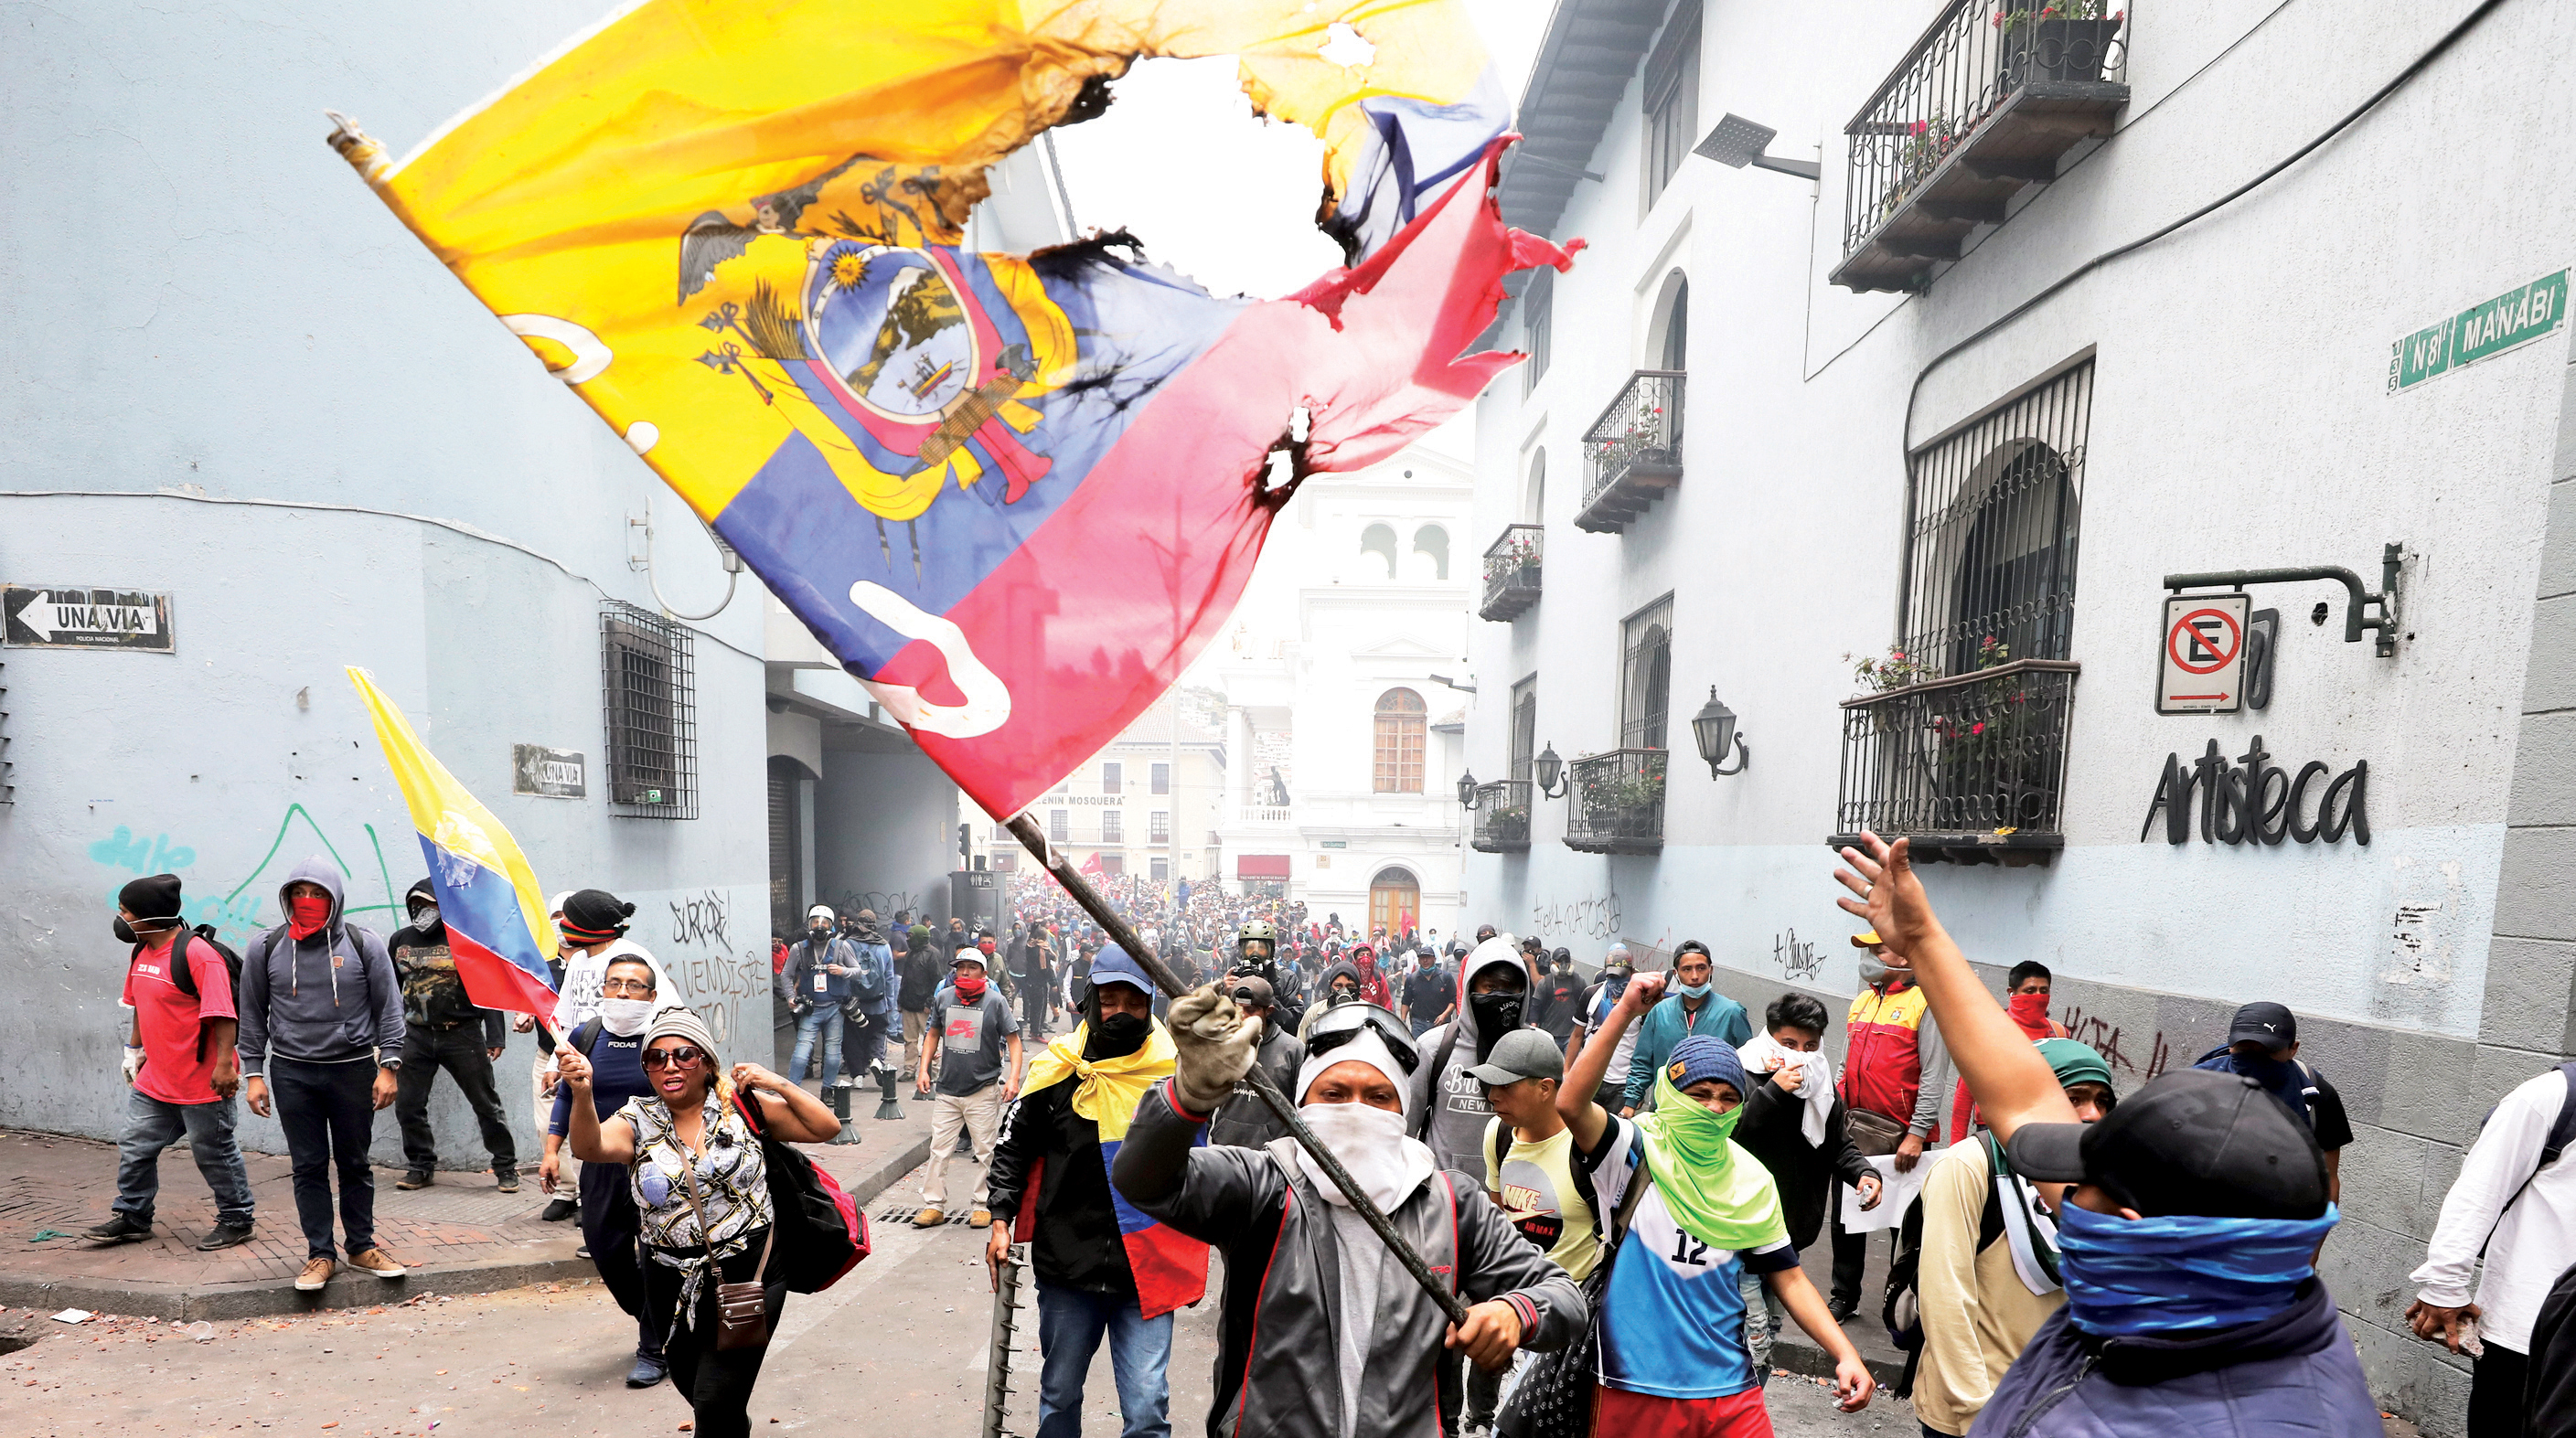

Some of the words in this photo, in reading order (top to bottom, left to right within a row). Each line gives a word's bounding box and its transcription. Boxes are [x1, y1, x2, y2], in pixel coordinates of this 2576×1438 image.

[2463, 284, 2555, 354] MANABI
[2389, 377, 2398, 391] 5
[57, 606, 103, 632] UNA
[107, 608, 144, 631] VIA
[2188, 622, 2222, 662] E
[1037, 795, 1065, 804] ENIN
[2141, 734, 2370, 846] Artisteca
[1459, 1099, 1486, 1112] NEW
[1502, 1184, 1541, 1212] NIKE
[1524, 1220, 1536, 1233] AIR
[1536, 1224, 1555, 1237] MAX
[1672, 1228, 1708, 1266] 12
